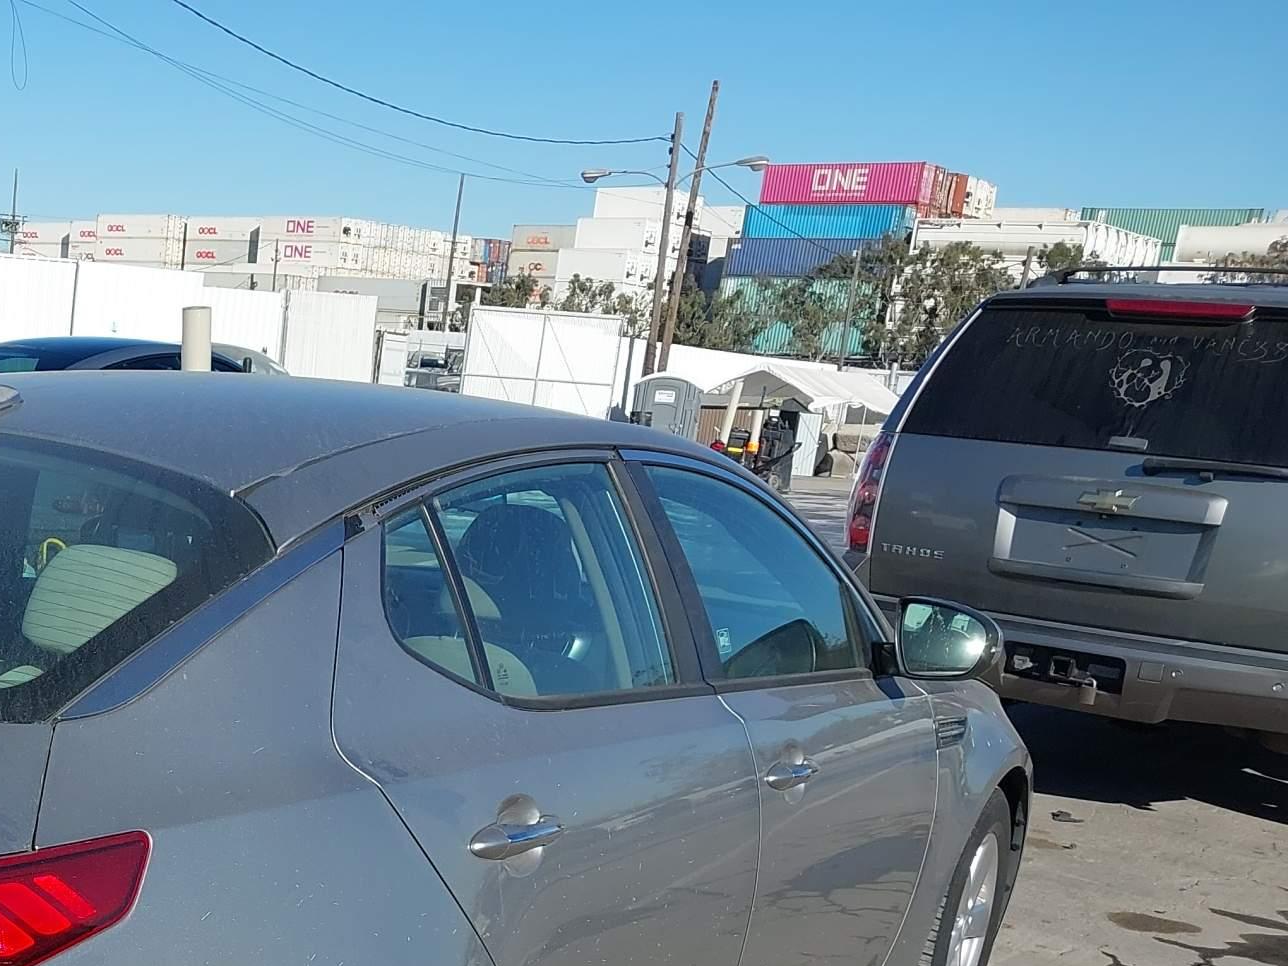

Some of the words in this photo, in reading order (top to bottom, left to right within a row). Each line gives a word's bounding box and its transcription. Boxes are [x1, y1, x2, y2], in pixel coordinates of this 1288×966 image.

[812, 168, 869, 190] ONE
[107, 224, 126, 232] OOCL
[198, 227, 217, 235] OOCL
[286, 220, 314, 234] ONE
[105, 248, 124, 256] OOCL
[196, 251, 216, 259] OOCL
[283, 245, 312, 259] ONE
